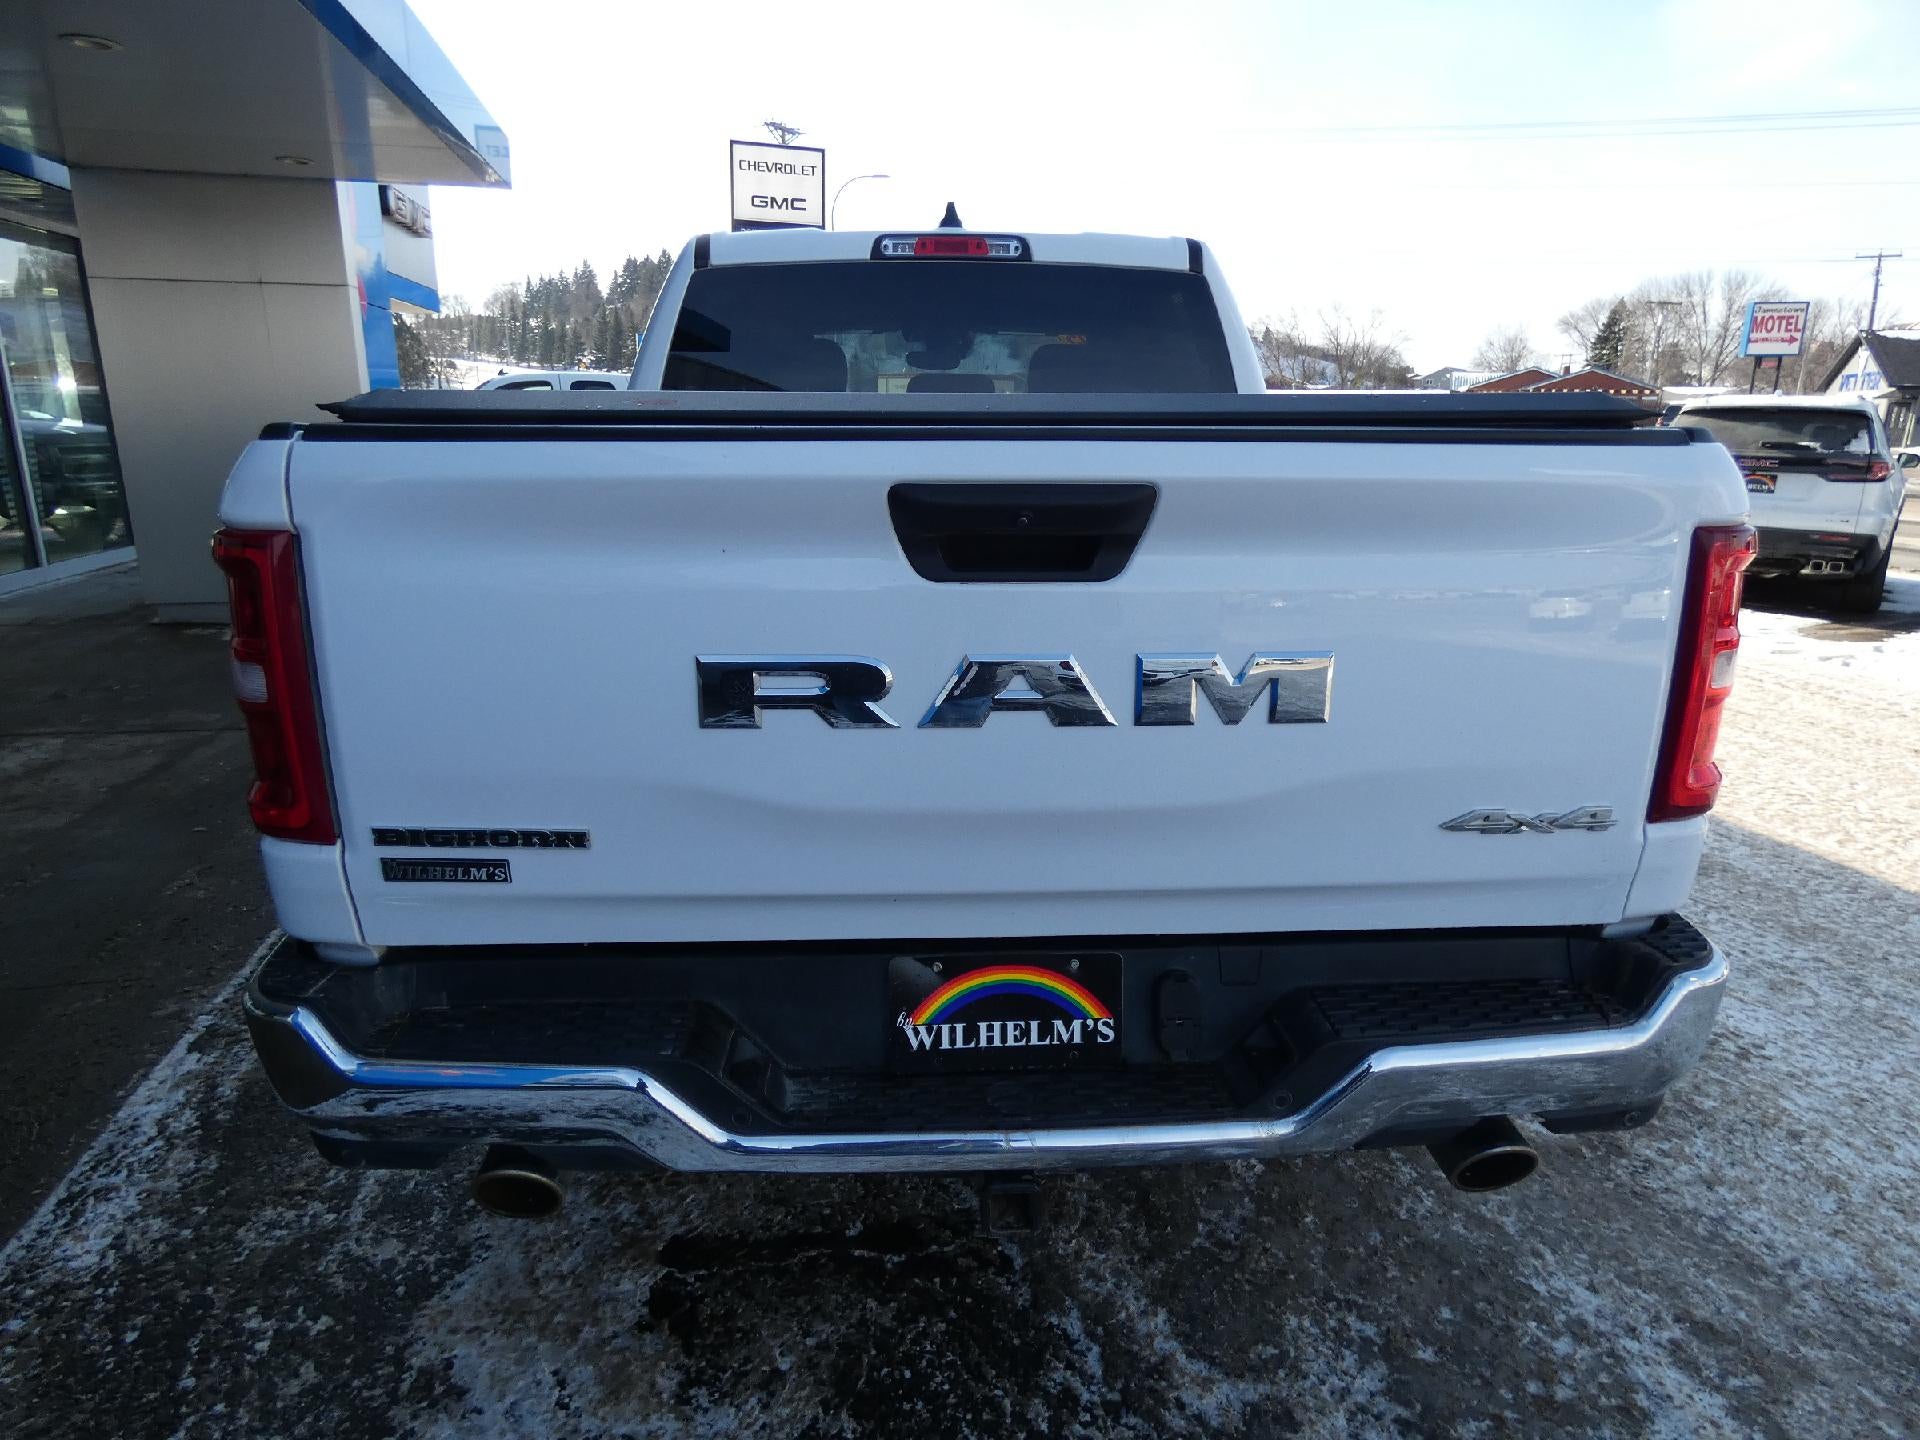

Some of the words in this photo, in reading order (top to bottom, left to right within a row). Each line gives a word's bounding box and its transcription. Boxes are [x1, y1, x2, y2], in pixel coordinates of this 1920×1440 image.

[738, 159, 818, 177] CHEVROLET
[750, 194, 807, 211] GMC
[1751, 315, 1802, 334] MOTEL
[1747, 483, 1775, 491] HELM'S
[695, 652, 1336, 729] RAM
[384, 859, 507, 881] WILHELM'S
[897, 1011, 916, 1031] by
[903, 1018, 1116, 1051] WILHELM'S
